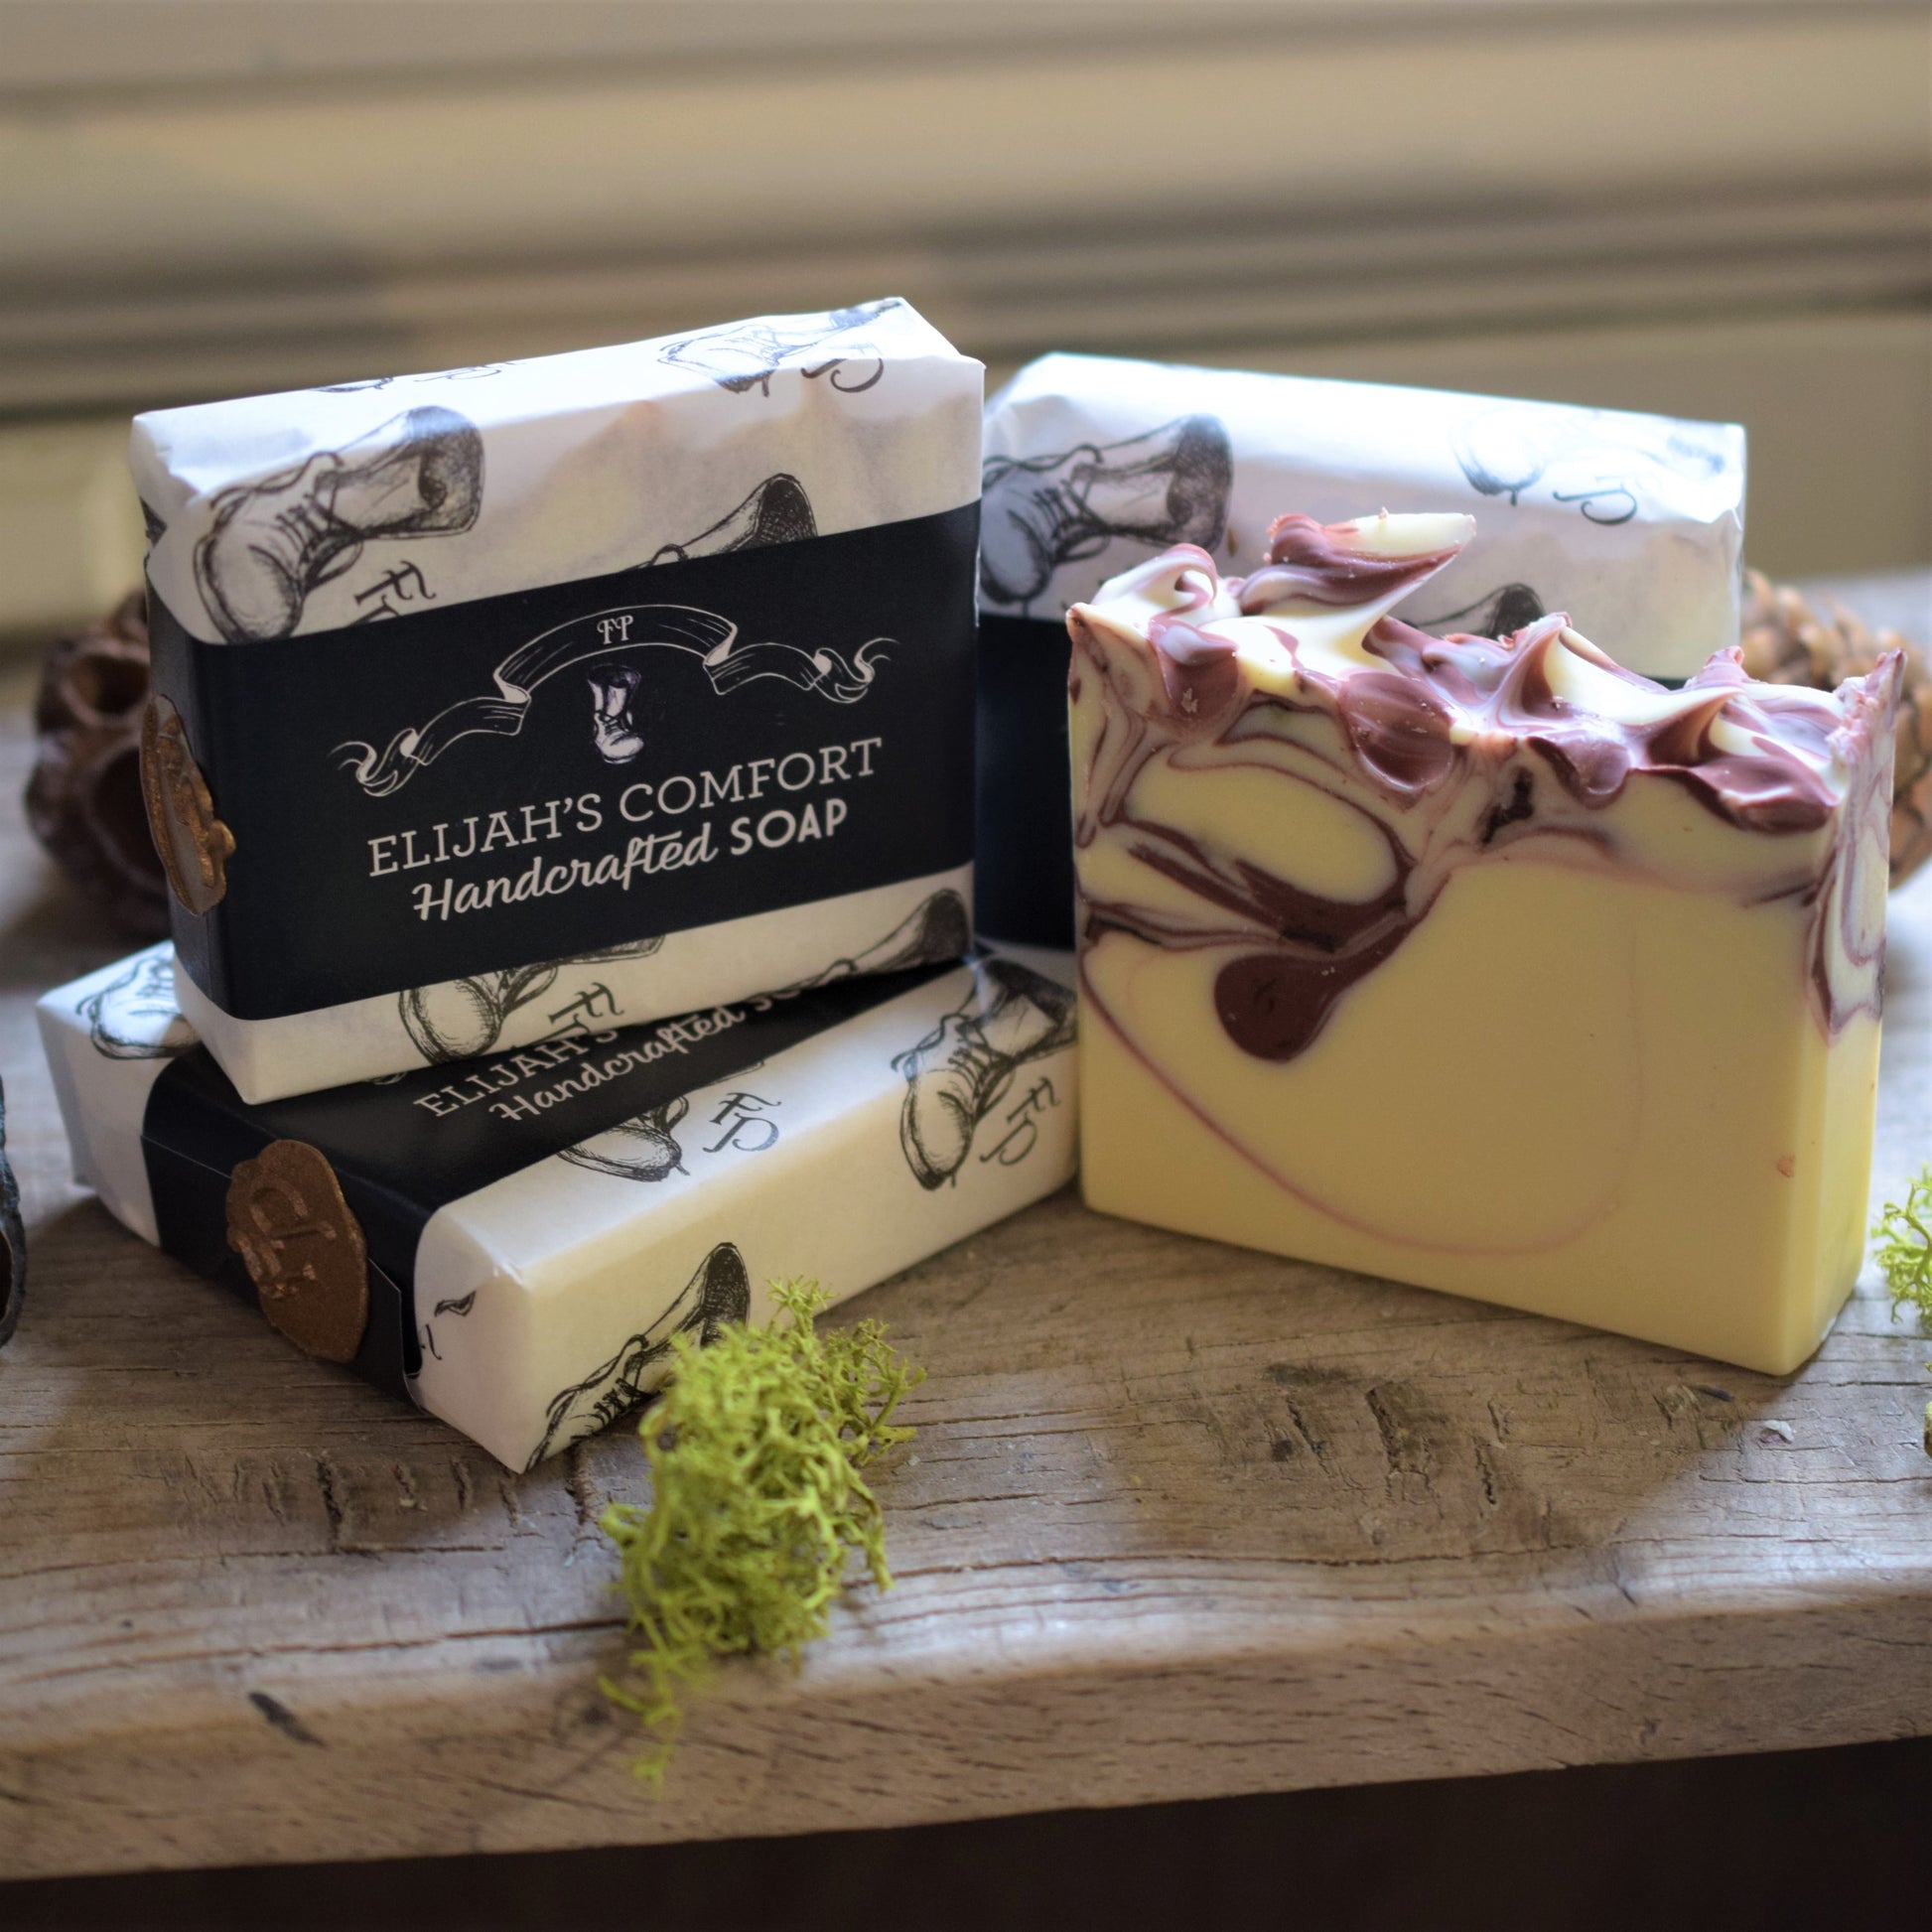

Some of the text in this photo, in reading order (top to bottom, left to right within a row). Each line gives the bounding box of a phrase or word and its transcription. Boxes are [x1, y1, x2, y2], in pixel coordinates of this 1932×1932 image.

[597, 615, 634, 645] FP
[367, 737, 882, 877] ELIJAH'S COMFORT
[411, 798, 848, 921] Handcrafted SOAP
[413, 1029, 619, 1117] ELIJAH
[488, 1006, 746, 1121] Handcrafted
